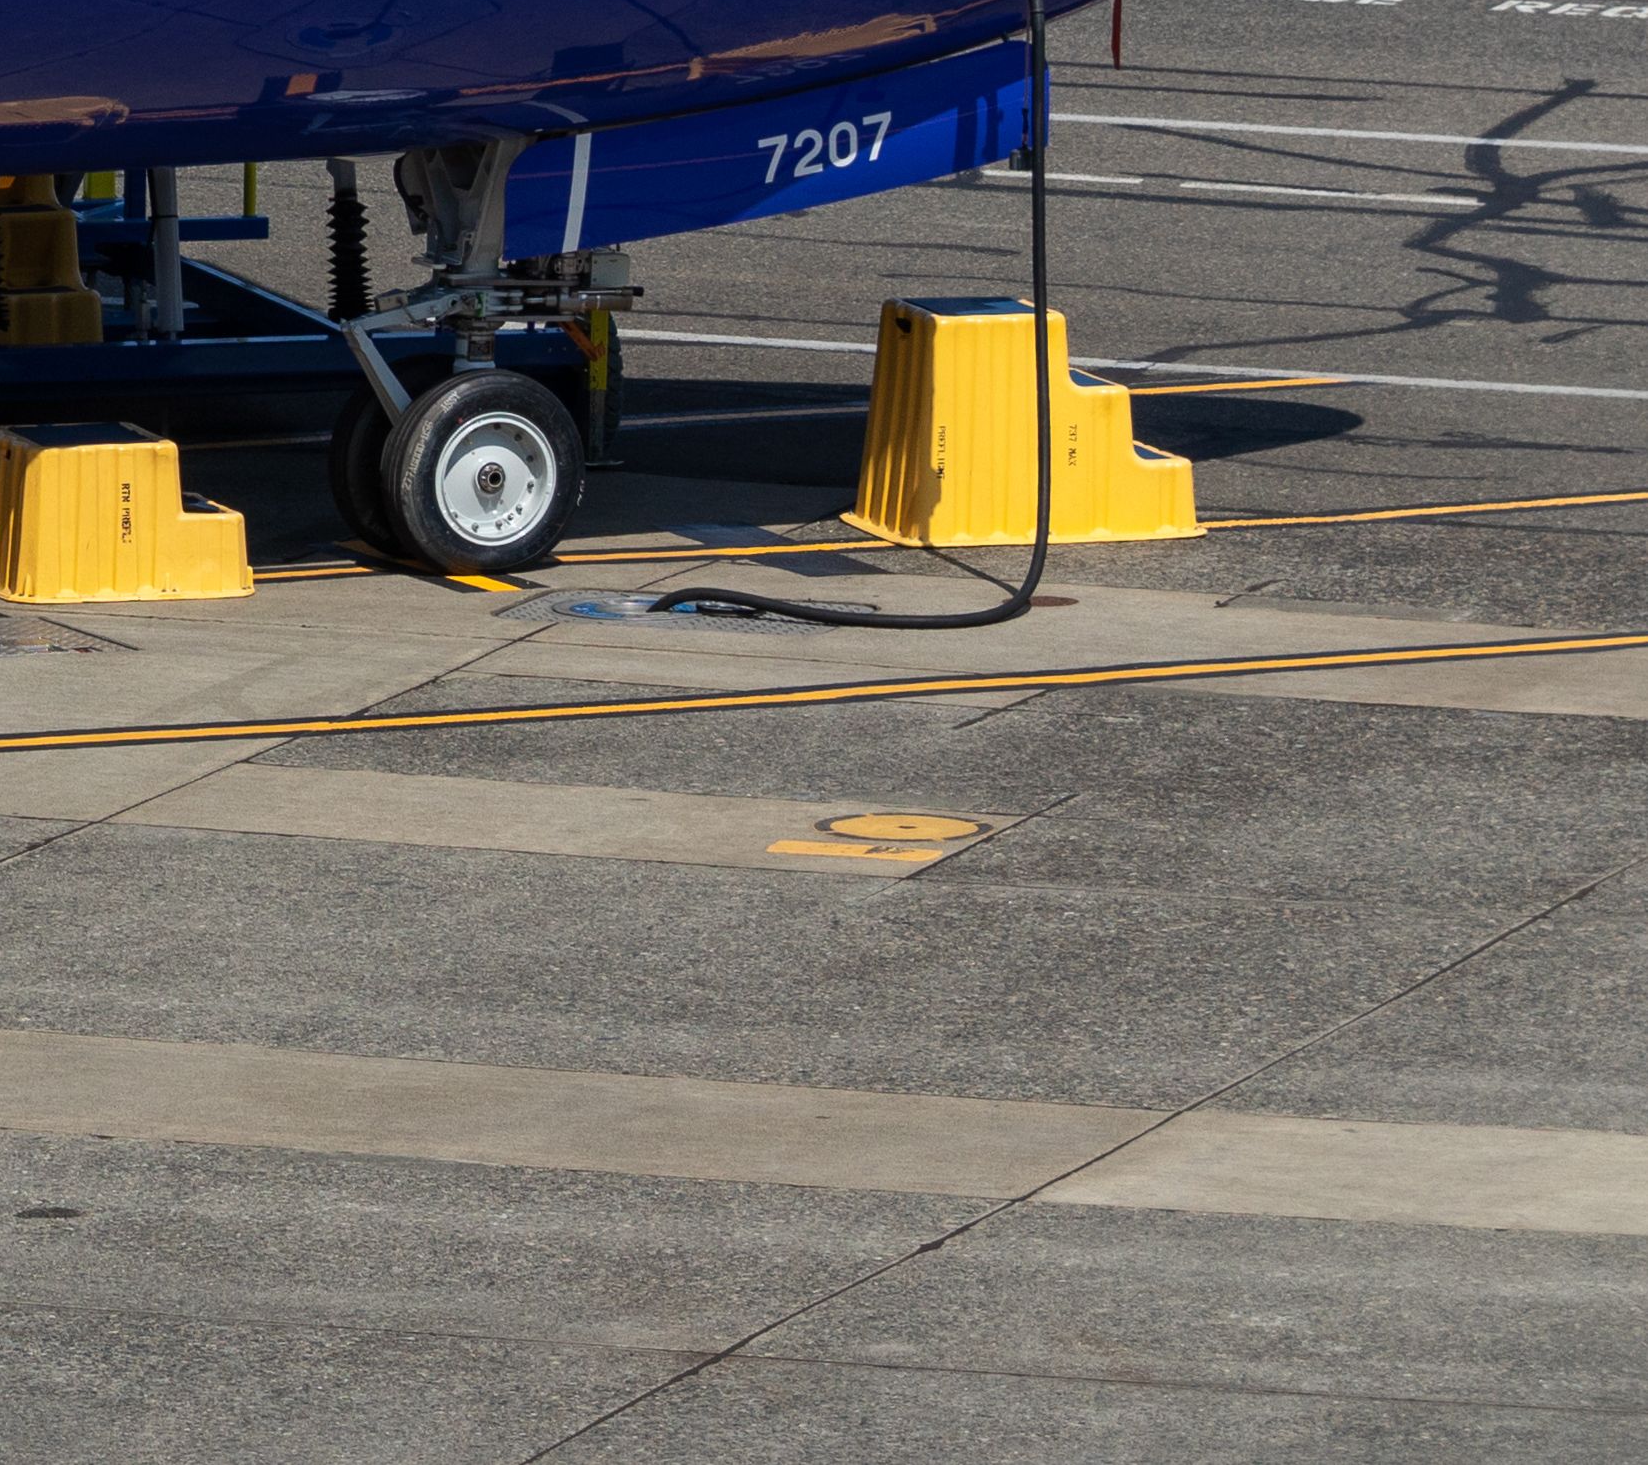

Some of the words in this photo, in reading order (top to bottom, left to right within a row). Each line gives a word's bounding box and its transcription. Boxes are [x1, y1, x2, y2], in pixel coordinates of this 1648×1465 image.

[758, 111, 892, 184] 7207
[1068, 424, 1078, 442] 737
[1068, 448, 1077, 467] MAX
[121, 483, 131, 503] RTN
